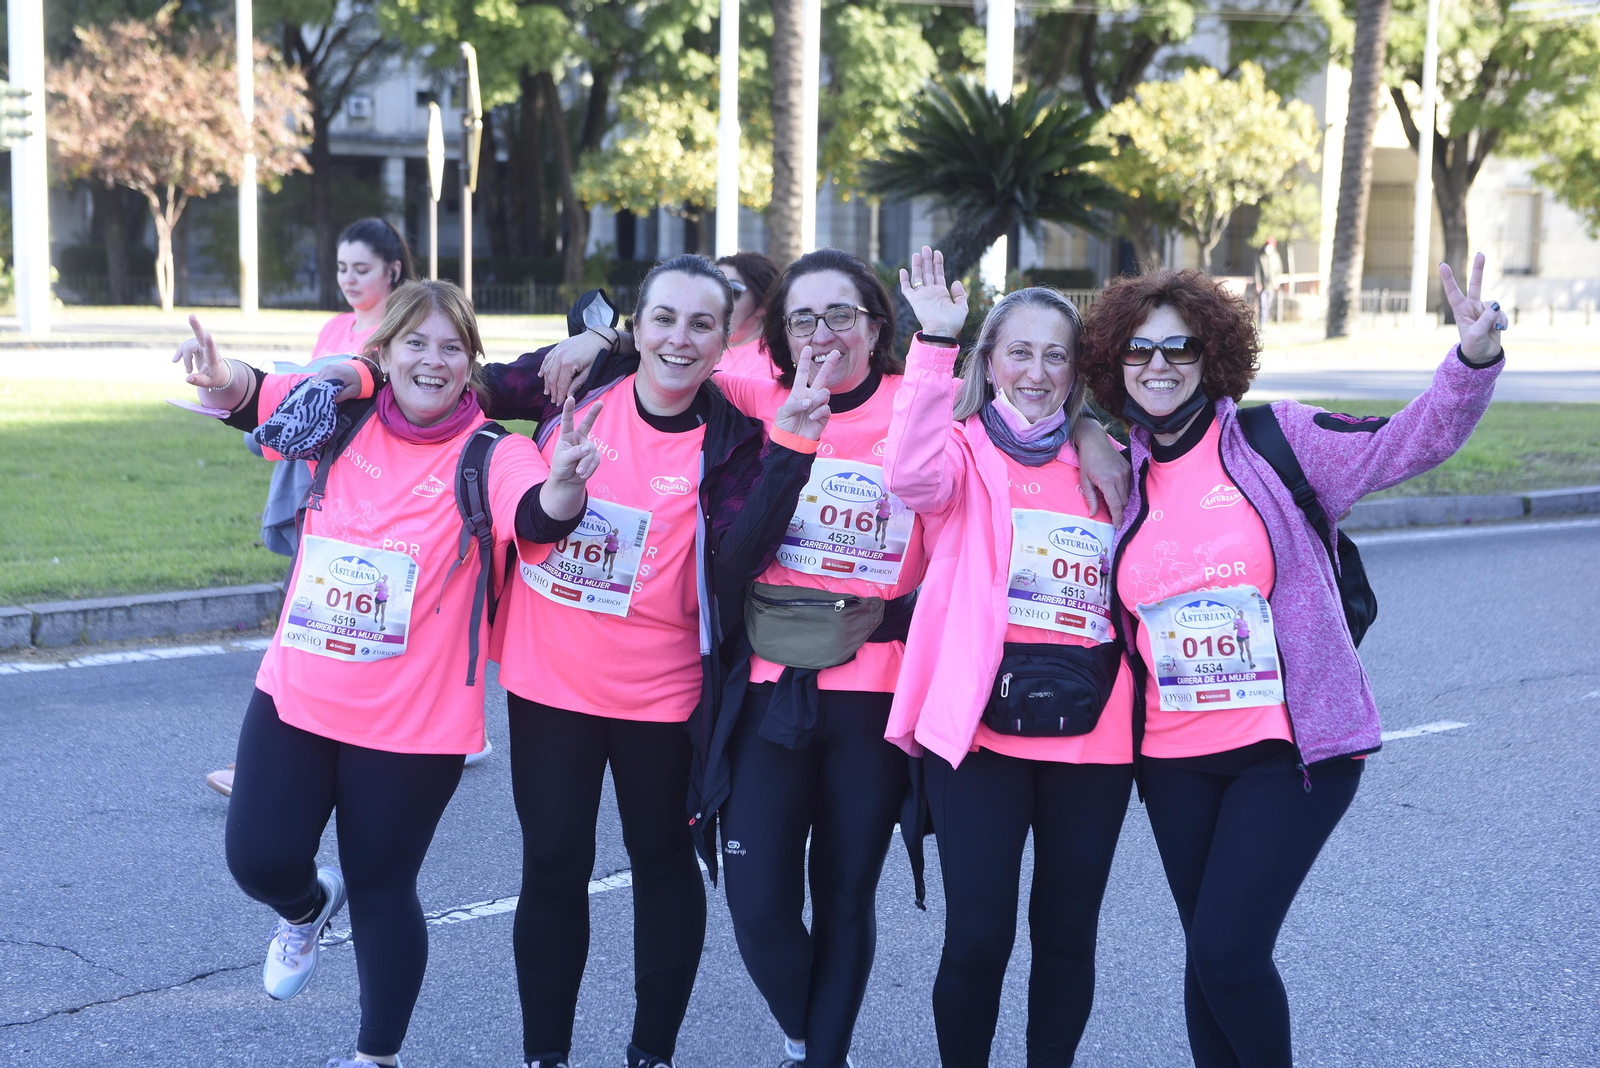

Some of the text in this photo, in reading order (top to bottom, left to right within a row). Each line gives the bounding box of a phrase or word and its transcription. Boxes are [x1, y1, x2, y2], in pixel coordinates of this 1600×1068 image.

[587, 433, 618, 461] YSHO
[342, 446, 382, 479] OYSHO
[824, 480, 878, 499] ASTURIANA
[580, 520, 606, 534] RIANA
[820, 504, 874, 532] 016
[383, 539, 420, 557] POR
[828, 532, 856, 546] 4523
[1054, 534, 1099, 553] ASTURIANA
[556, 537, 602, 564] 016
[780, 552, 817, 566] OYSHO
[800, 539, 884, 560] CARRERA DE LA MUJER
[332, 562, 376, 582] ASTURIANA
[523, 566, 549, 589] OYSHO
[558, 560, 584, 576] 4533
[870, 568, 892, 576] ZURICH
[1052, 558, 1098, 586] 016
[1204, 561, 1247, 582] POR
[562, 571, 573, 582] DE
[574, 574, 584, 585] LA
[585, 578, 611, 590] MUJER
[326, 588, 373, 614] 016
[597, 597, 621, 606] ZURICH
[1061, 586, 1086, 600] 4513
[1008, 606, 1050, 620] OYSHO
[1032, 593, 1106, 616] CARRERA DE LA MUJER
[332, 614, 356, 628] 4519
[1180, 612, 1232, 623] ASTURIANA
[287, 631, 322, 647] OYSHO
[306, 620, 384, 642] CARRERA DE LA MUJER
[1182, 635, 1236, 658] 016
[1194, 663, 1224, 674] 4534
[1177, 672, 1256, 685] CARRERA DE LA MUJER
[1164, 692, 1192, 703] OYSHO
